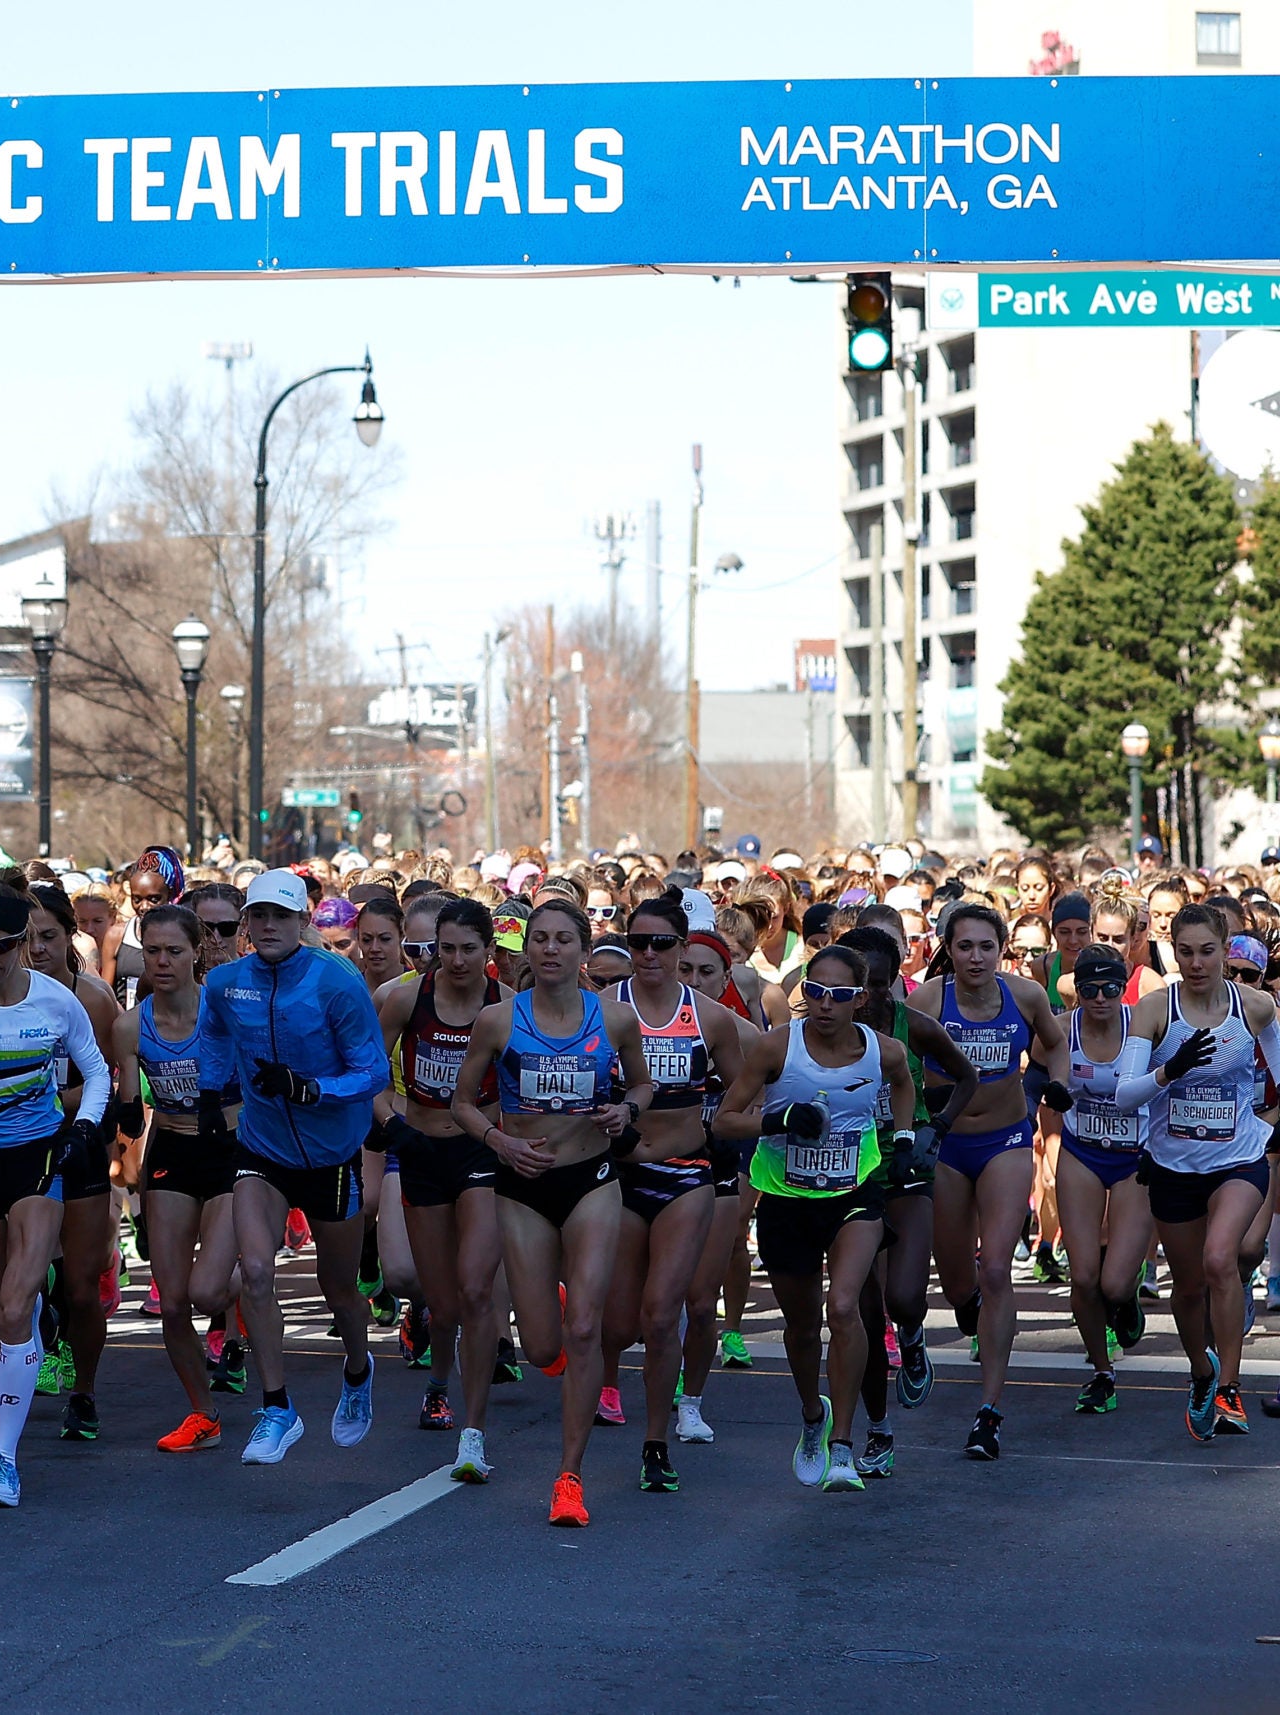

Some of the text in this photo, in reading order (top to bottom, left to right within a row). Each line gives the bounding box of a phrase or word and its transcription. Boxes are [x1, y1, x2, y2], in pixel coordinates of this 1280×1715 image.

[741, 124, 1060, 166] MARATHON
[84, 134, 300, 221] TEAM
[332, 128, 622, 216] TRIALS
[742, 175, 1058, 215] ATLANTA, GA
[990, 284, 1070, 315] Park
[1089, 284, 1157, 314] Ave
[1176, 283, 1252, 314] West
[20, 1028, 48, 1039] HOKA
[973, 1028, 997, 1036] OLYMPIC
[430, 1053, 446, 1063] TEAM
[653, 1045, 674, 1053] TRIALS
[960, 1045, 1009, 1063] ZALONE
[171, 1059, 195, 1069] OLYMPIC
[540, 1056, 552, 1064] U.S.
[645, 1055, 687, 1077] FFER
[153, 1076, 198, 1095] FLANAG
[536, 1074, 578, 1094] HALL
[1101, 1104, 1120, 1112] OLYMPI
[1171, 1104, 1234, 1120] A. SCHNEIDER
[1085, 1116, 1129, 1136] JONES
[829, 1133, 845, 1141] MPIC
[795, 1147, 851, 1171] LINDEN
